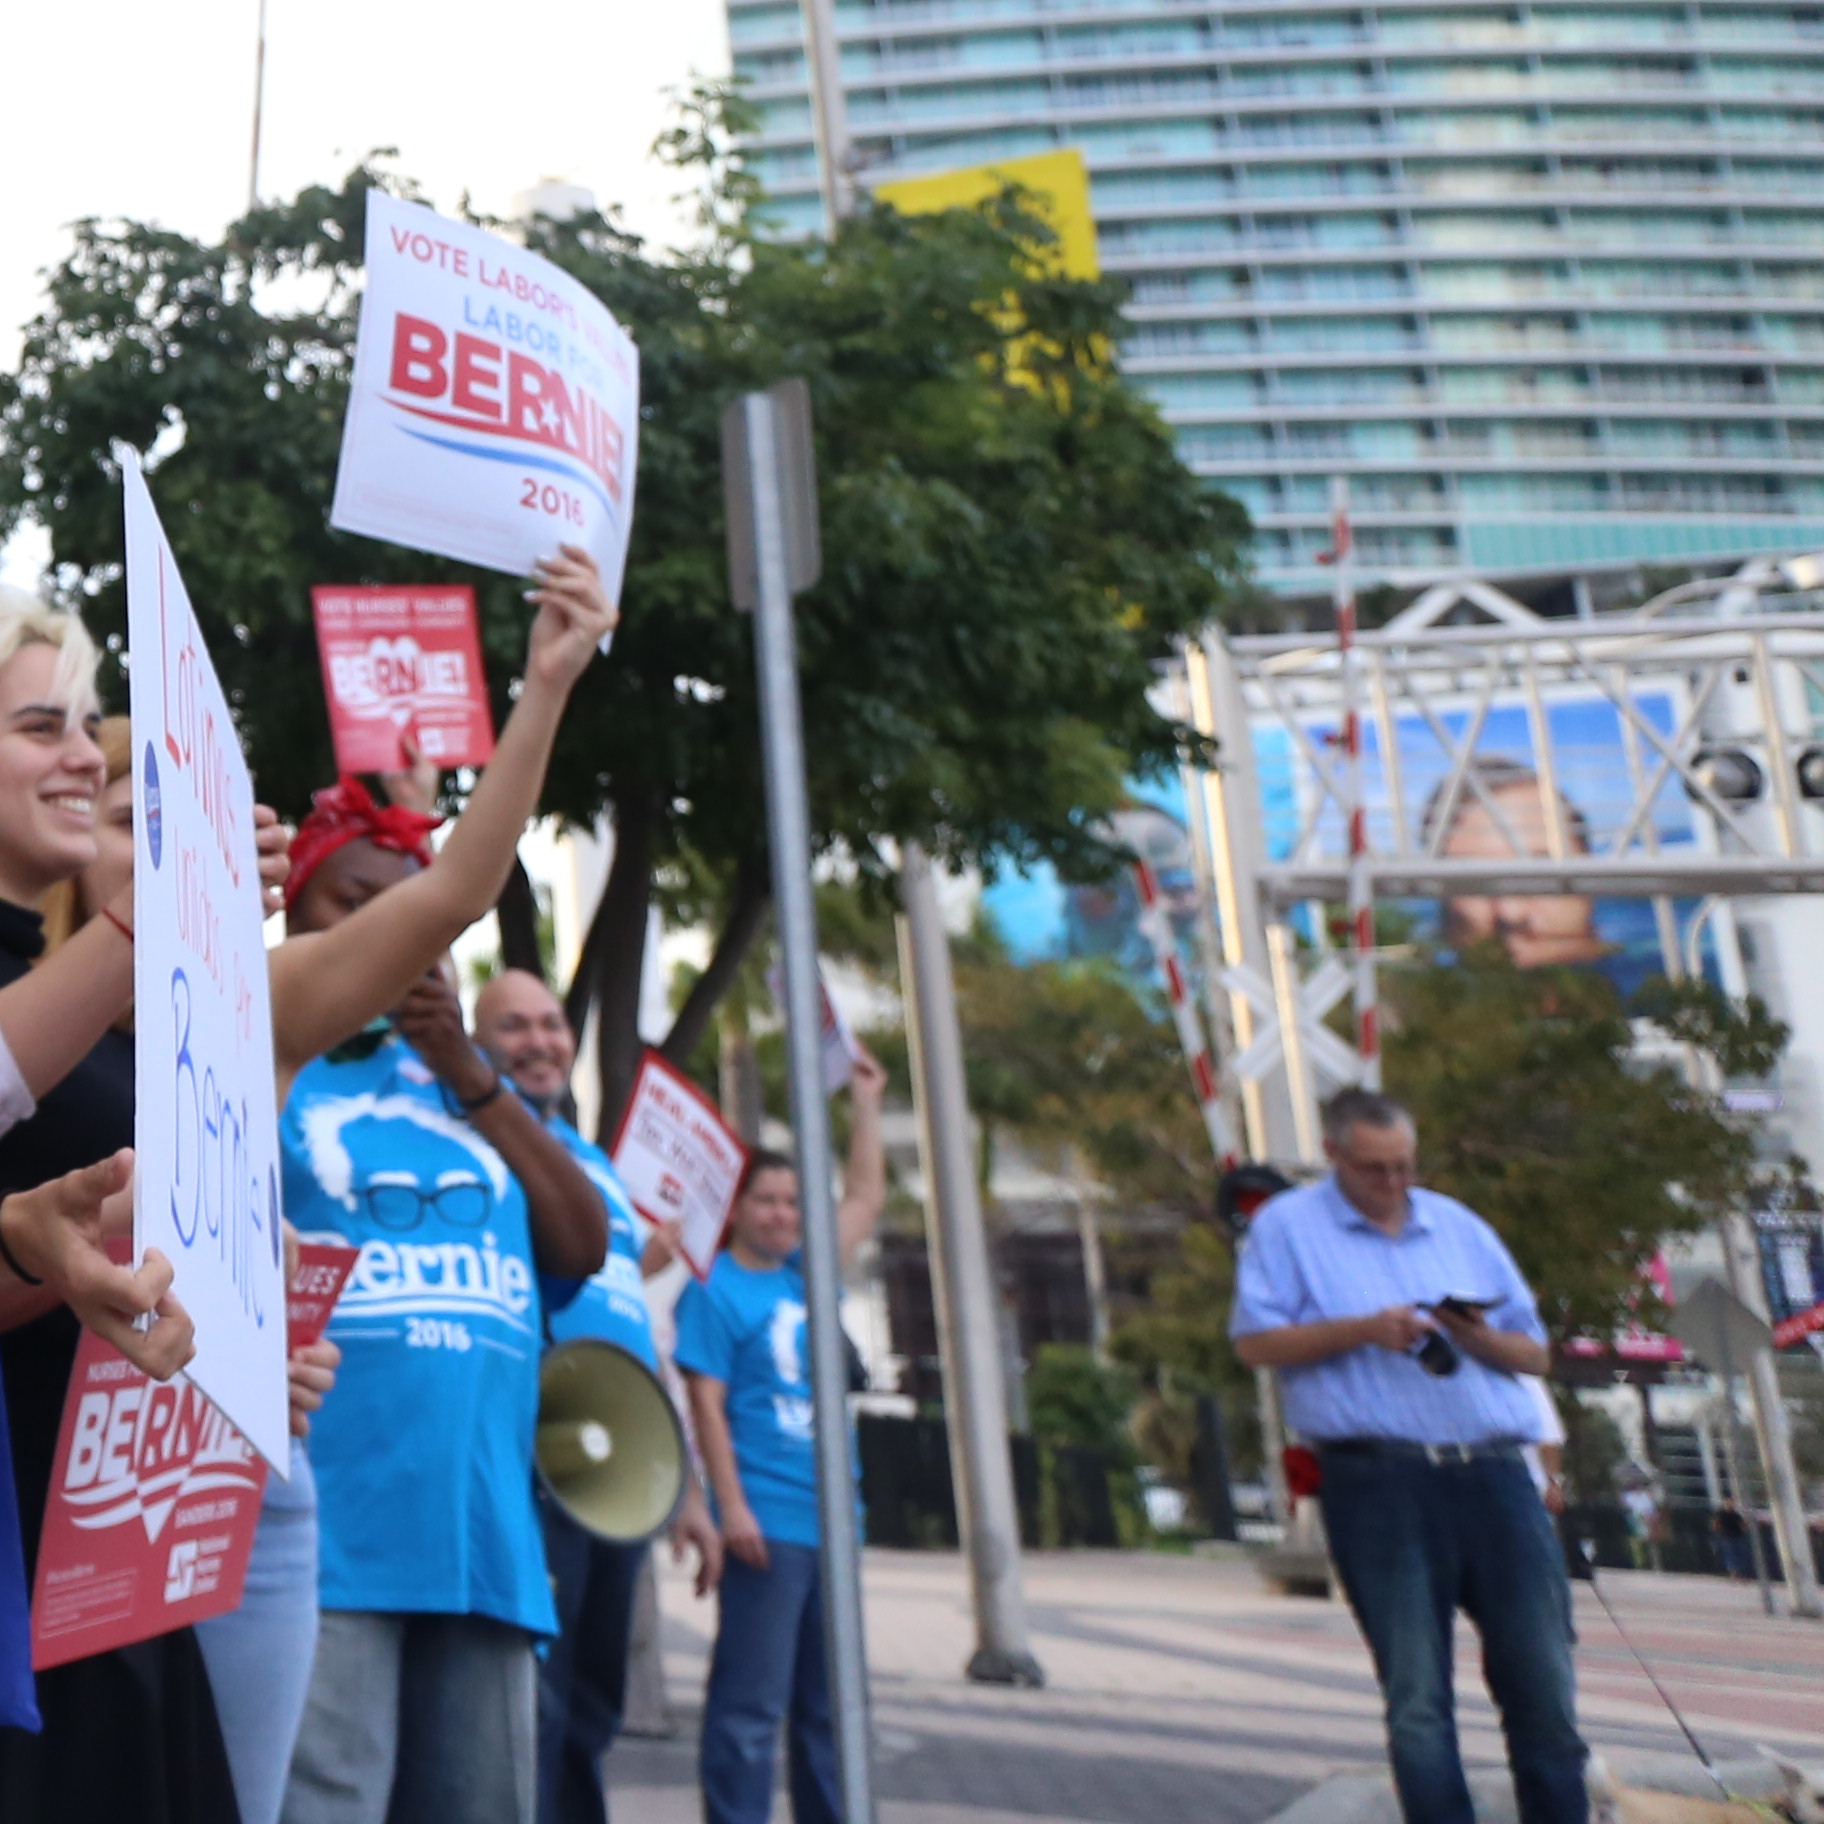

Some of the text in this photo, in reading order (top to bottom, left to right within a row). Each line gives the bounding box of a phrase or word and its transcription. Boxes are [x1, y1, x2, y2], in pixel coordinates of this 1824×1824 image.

[389, 224, 469, 278] VOTE
[463, 295, 561, 363] LABOR
[389, 310, 625, 506] BERNIE
[519, 477, 584, 527] 2016
[298, 1228, 533, 1313] ernie
[405, 1316, 473, 1353] 2016
